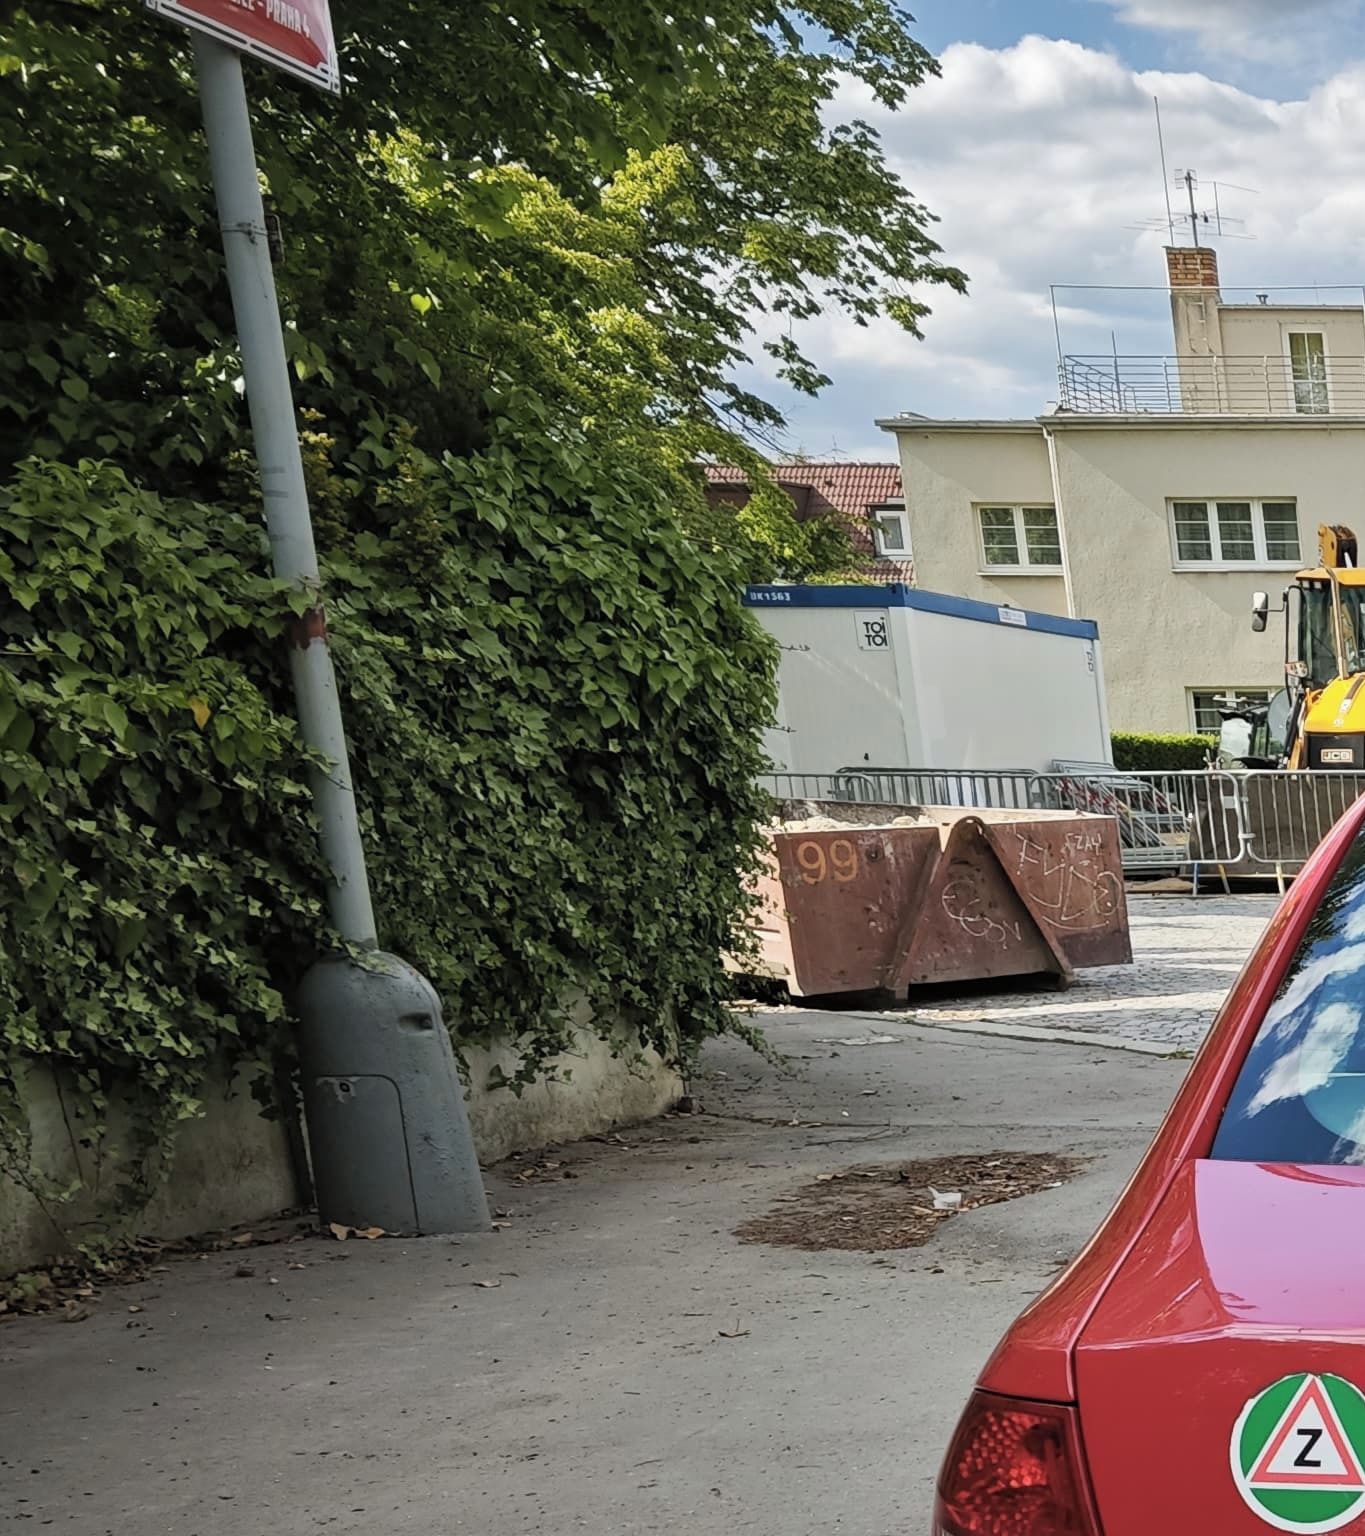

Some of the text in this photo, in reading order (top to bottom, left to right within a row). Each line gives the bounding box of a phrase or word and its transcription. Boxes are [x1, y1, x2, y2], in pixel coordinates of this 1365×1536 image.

[266, 0, 301, 34] PRAHA
[302, 13, 310, 38] 4
[1322, 751, 1351, 761] JCB
[796, 838, 859, 885] 99
[1294, 1428, 1323, 1467] Z
